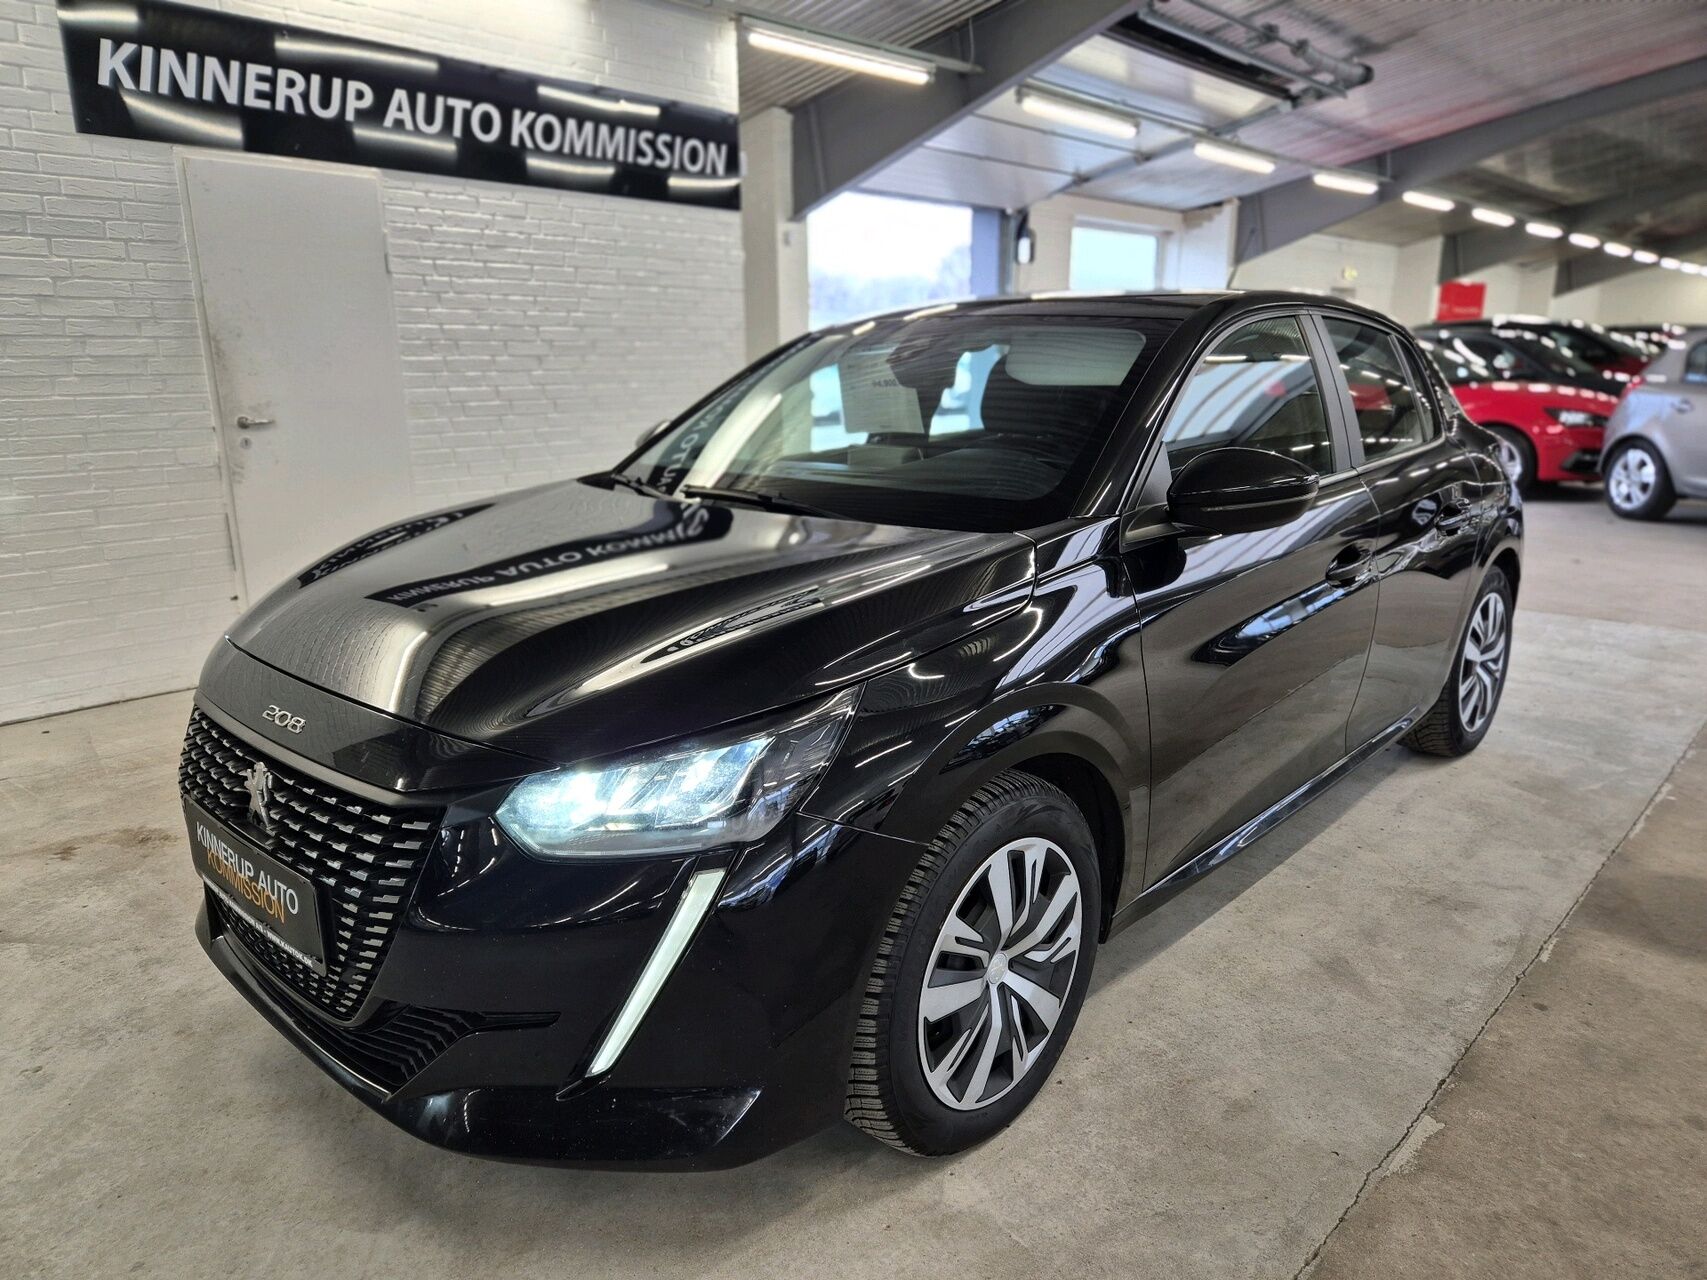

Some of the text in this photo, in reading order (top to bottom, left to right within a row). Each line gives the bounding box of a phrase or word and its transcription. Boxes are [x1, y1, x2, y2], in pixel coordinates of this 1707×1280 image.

[98, 38, 727, 176] KINNERUP AUTO KOMMISSION
[262, 704, 306, 733] 208
[196, 821, 254, 879] KINNERUP
[257, 870, 299, 915] AUTO
[207, 848, 285, 924] KOMMISSION
